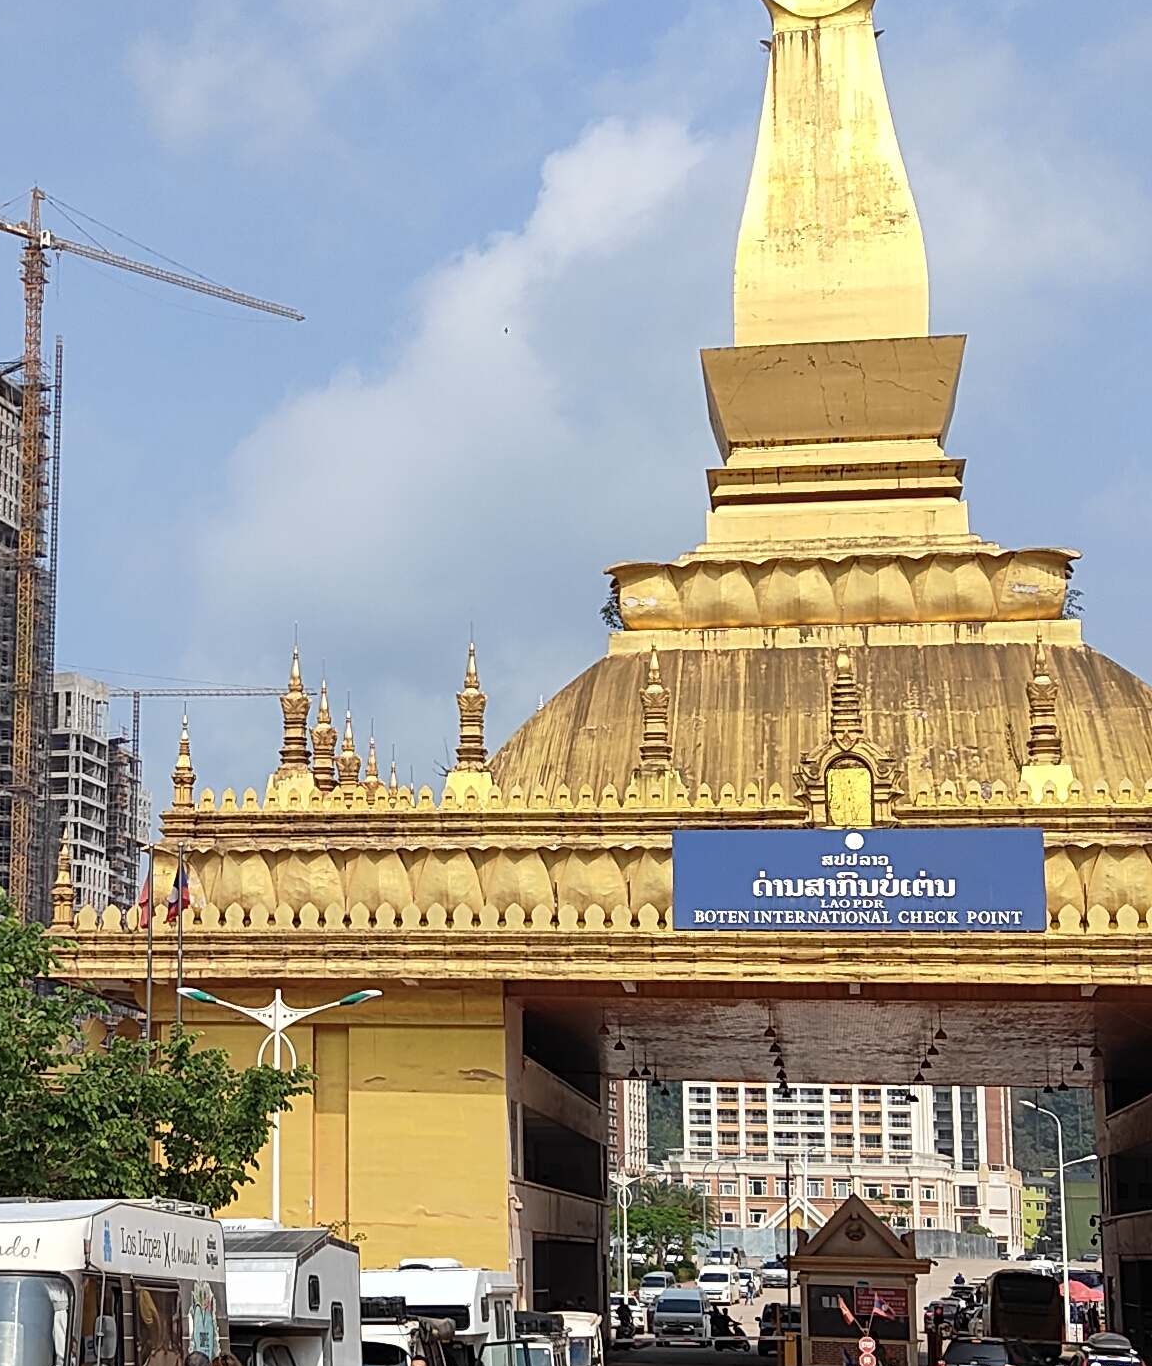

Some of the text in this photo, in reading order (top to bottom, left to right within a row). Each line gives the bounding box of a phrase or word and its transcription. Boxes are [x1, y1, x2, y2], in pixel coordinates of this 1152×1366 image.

[820, 899, 886, 909] LAO PDR
[693, 910, 1023, 925] BOTEN INTERNATIONAL CHECK POINT
[120, 1227, 137, 1256] Los
[163, 1231, 171, 1269] X
